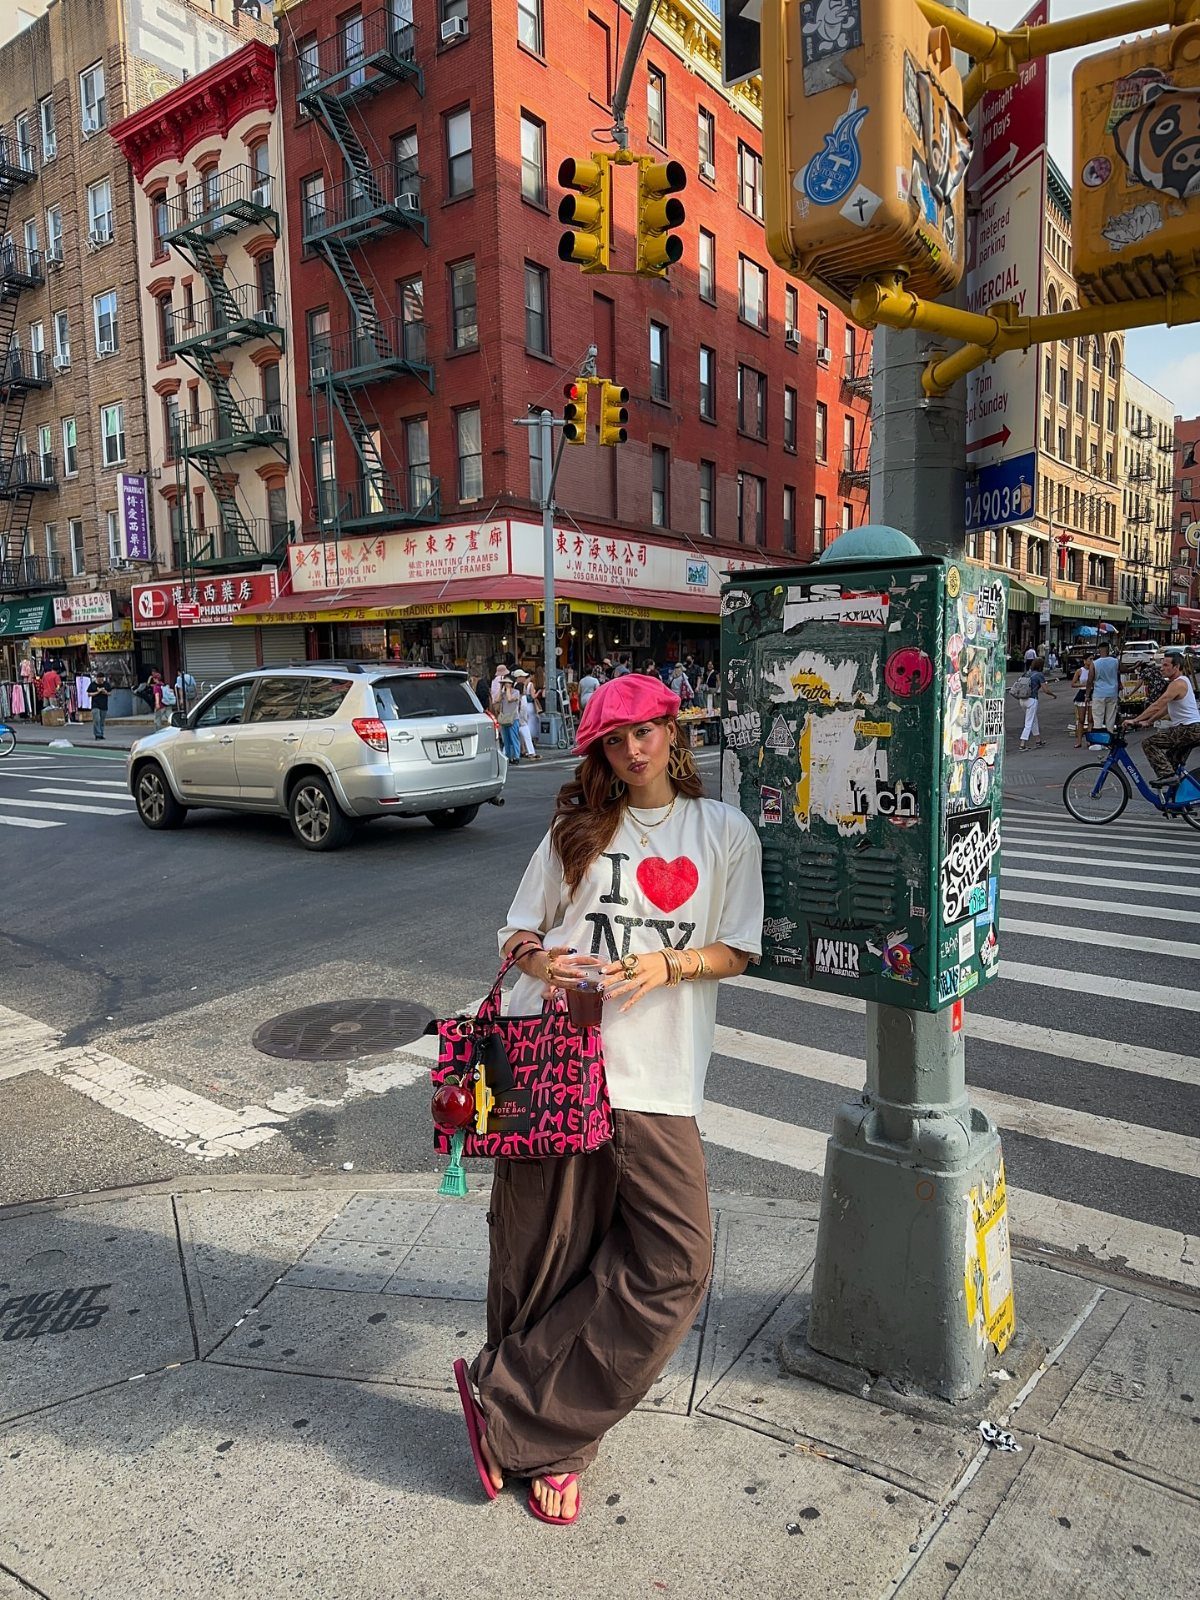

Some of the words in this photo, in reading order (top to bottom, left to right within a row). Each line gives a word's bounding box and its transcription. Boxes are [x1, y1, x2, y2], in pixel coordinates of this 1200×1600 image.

[983, 86, 1013, 123] Midnight
[1019, 62, 1037, 90] 7am
[982, 127, 992, 150] All
[993, 113, 1011, 140] Days
[821, 167, 845, 182] TORCH
[980, 207, 1010, 244] metered
[981, 202, 996, 223] hour
[979, 234, 1006, 268] parking
[967, 264, 1019, 312] MMERCIAL
[975, 375, 993, 398] 7pm
[965, 403, 976, 428] ept
[978, 391, 1009, 419] Sunday
[403, 527, 502, 557] 新東方畫廊
[556, 531, 647, 566] 東方海味公司
[363, 564, 377, 574] INC
[426, 557, 463, 568] PAINTING
[466, 553, 499, 564] FRAMES
[426, 566, 457, 576] PICTURE
[460, 563, 491, 574] FRAMES
[588, 562, 623, 576] TRADING
[626, 567, 639, 578] INC
[573, 571, 584, 580] 205
[585, 573, 608, 583] GRAND
[200, 603, 242, 616] PHARMACY
[400, 603, 434, 616] TRADING
[985, 699, 1004, 712] NASTY
[941, 829, 980, 886] Keep
[946, 827, 998, 918] Smiling
[599, 852, 630, 906] I
[585, 912, 696, 963] NY
[830, 966, 860, 979] VIBRATIONS
[511, 1106, 527, 1114] BAG
[0, 1283, 112, 1318] FIGHT
[2, 1305, 109, 1342] CLUB
